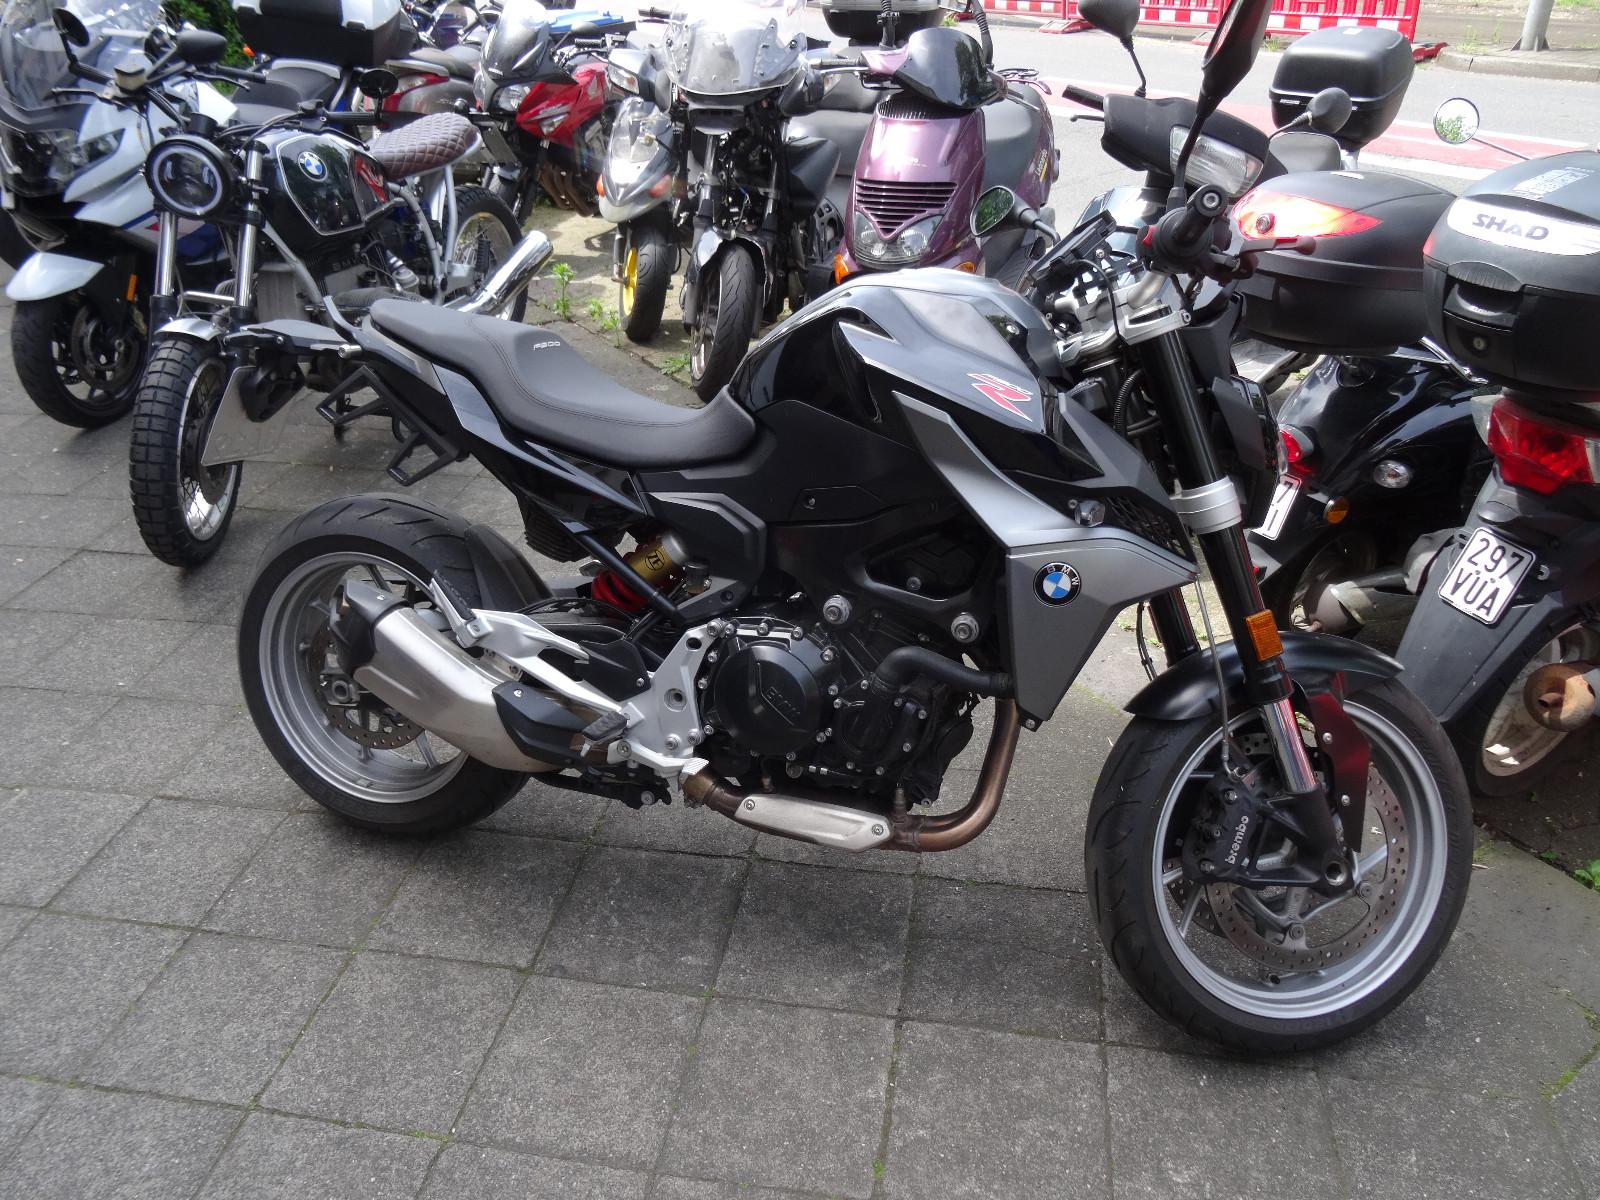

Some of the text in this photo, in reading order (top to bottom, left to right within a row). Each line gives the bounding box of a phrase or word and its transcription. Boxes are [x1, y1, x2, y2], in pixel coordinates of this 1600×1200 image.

[1472, 213, 1549, 241] SHAD
[1046, 564, 1079, 585] BMW
[1467, 538, 1525, 579] 297
[1450, 568, 1500, 616] VUA
[1224, 815, 1249, 865] brembo
